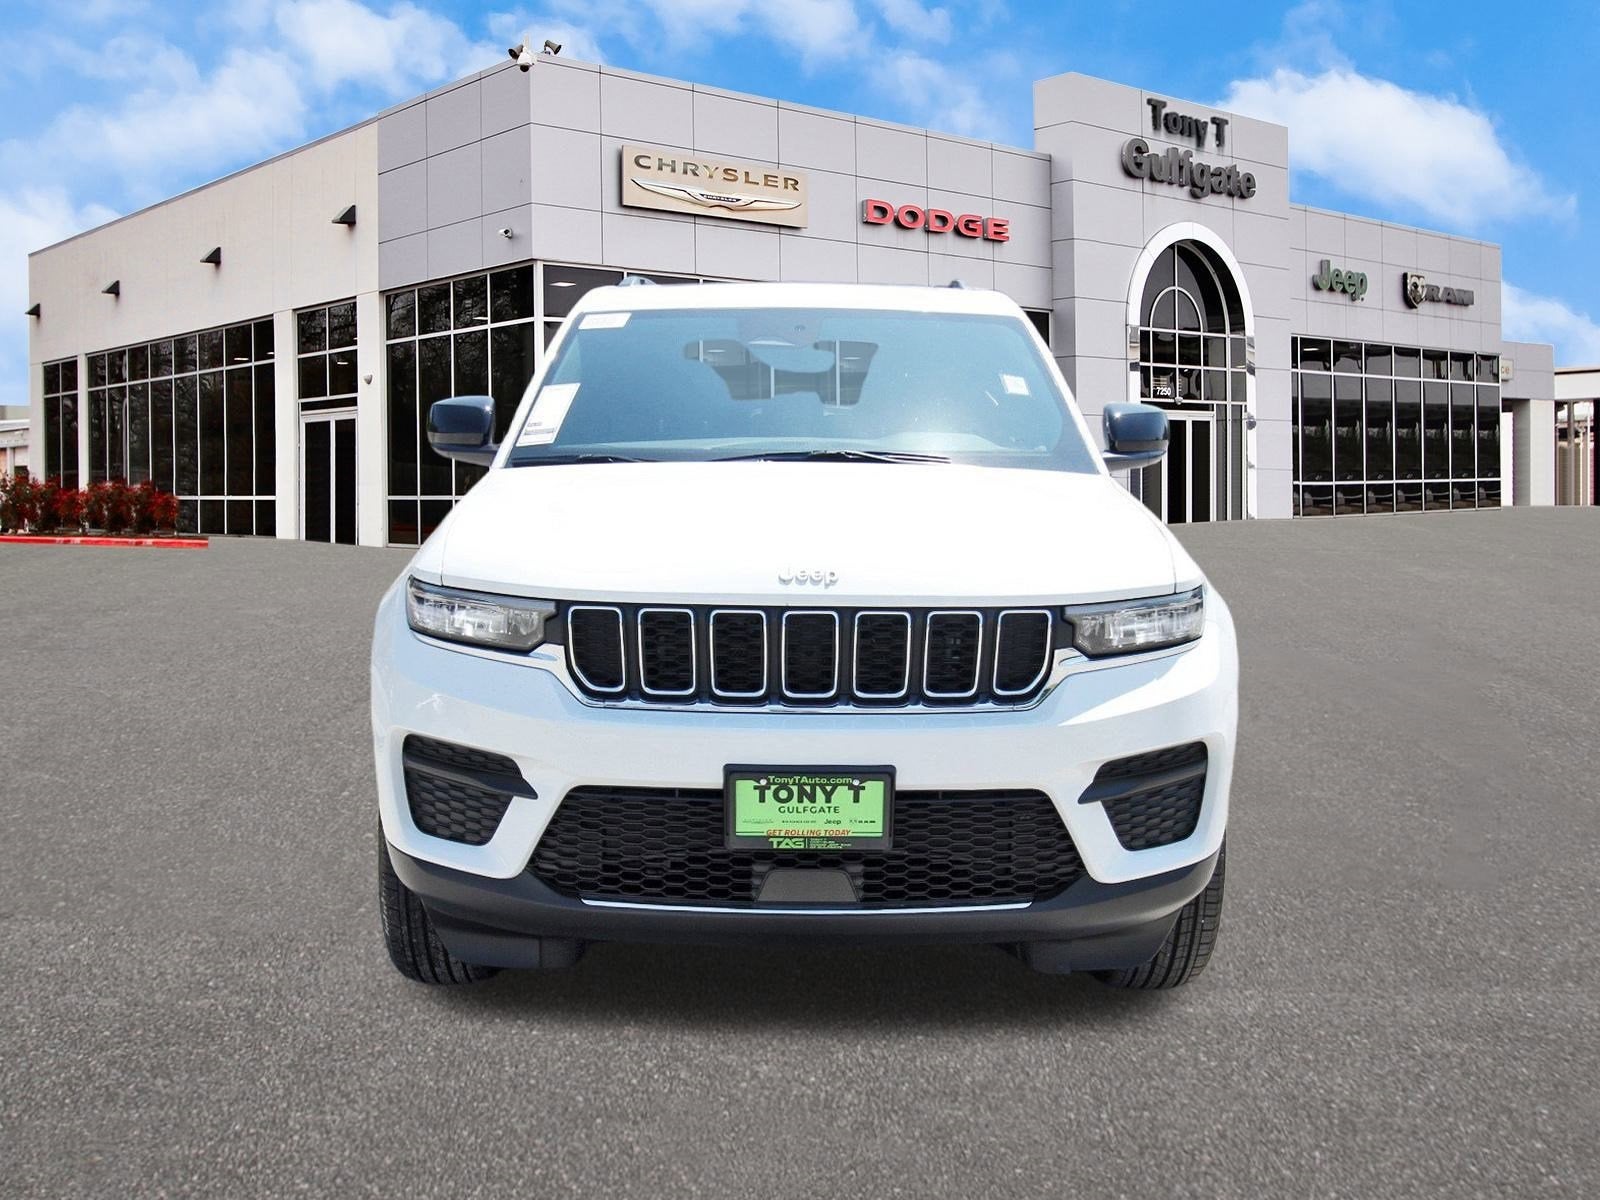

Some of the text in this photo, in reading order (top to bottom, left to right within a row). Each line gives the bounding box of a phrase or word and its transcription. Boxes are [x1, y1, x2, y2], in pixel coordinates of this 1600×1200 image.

[1147, 98, 1229, 149] Tony T
[634, 154, 800, 191] CHRYSLER
[1121, 137, 1256, 199] Gulfgate
[862, 199, 1010, 242] DODGE
[1312, 259, 1368, 301] Jeep
[1423, 284, 1475, 306] RAM
[1156, 387, 1172, 396] 7250
[777, 567, 839, 589] Jeep
[768, 775, 852, 785] TonyTAuto.com
[753, 784, 866, 804] TONY T
[778, 806, 840, 814] GULFGATE
[766, 829, 851, 837] GET ROLLING TODAY
